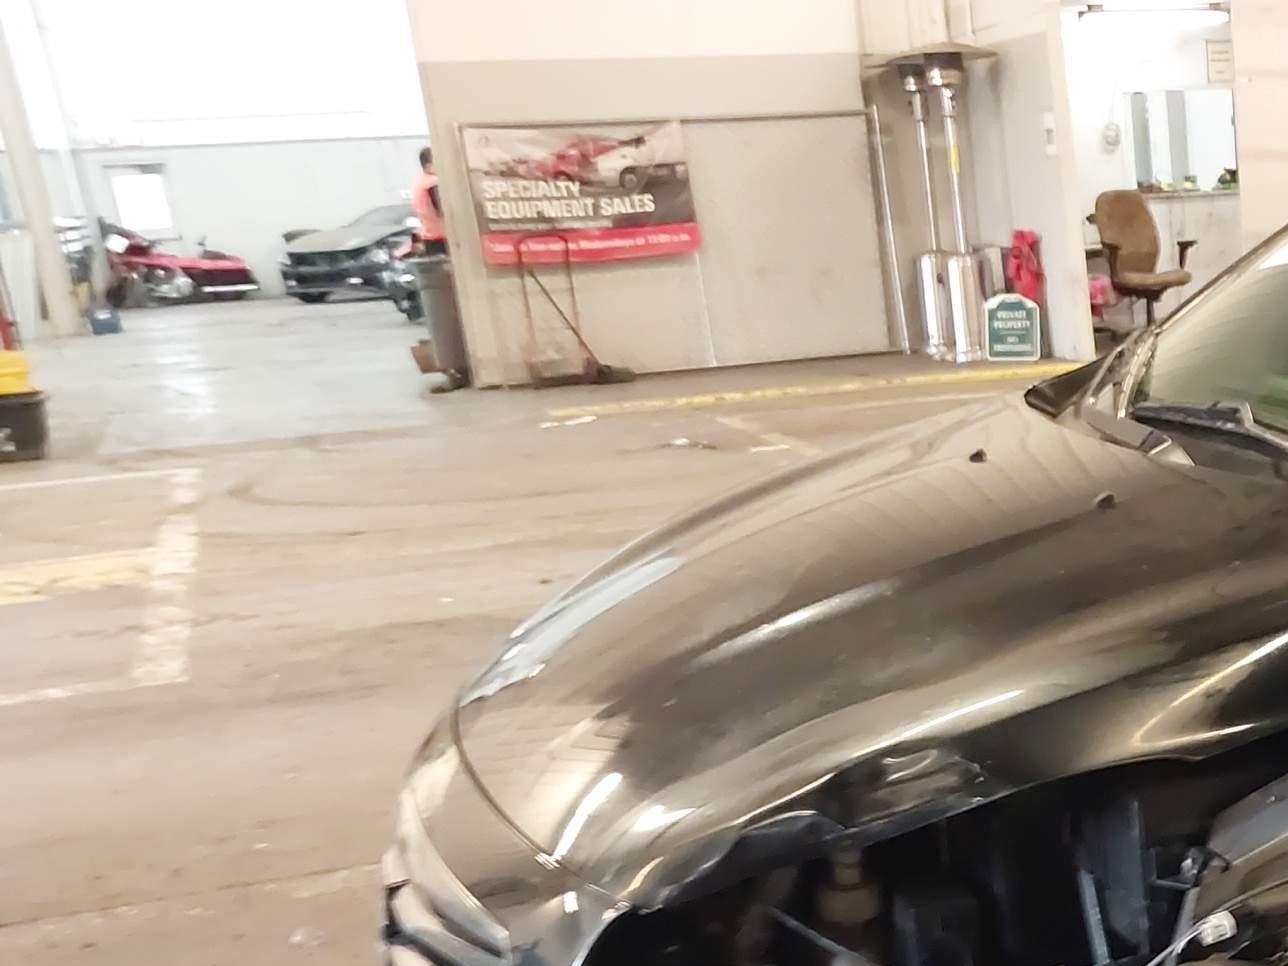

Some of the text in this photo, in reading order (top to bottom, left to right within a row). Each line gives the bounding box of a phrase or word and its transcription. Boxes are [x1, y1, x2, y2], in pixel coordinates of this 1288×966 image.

[484, 179, 580, 198] SPECIALTY
[486, 193, 655, 219] EQUIPMENT SALES
